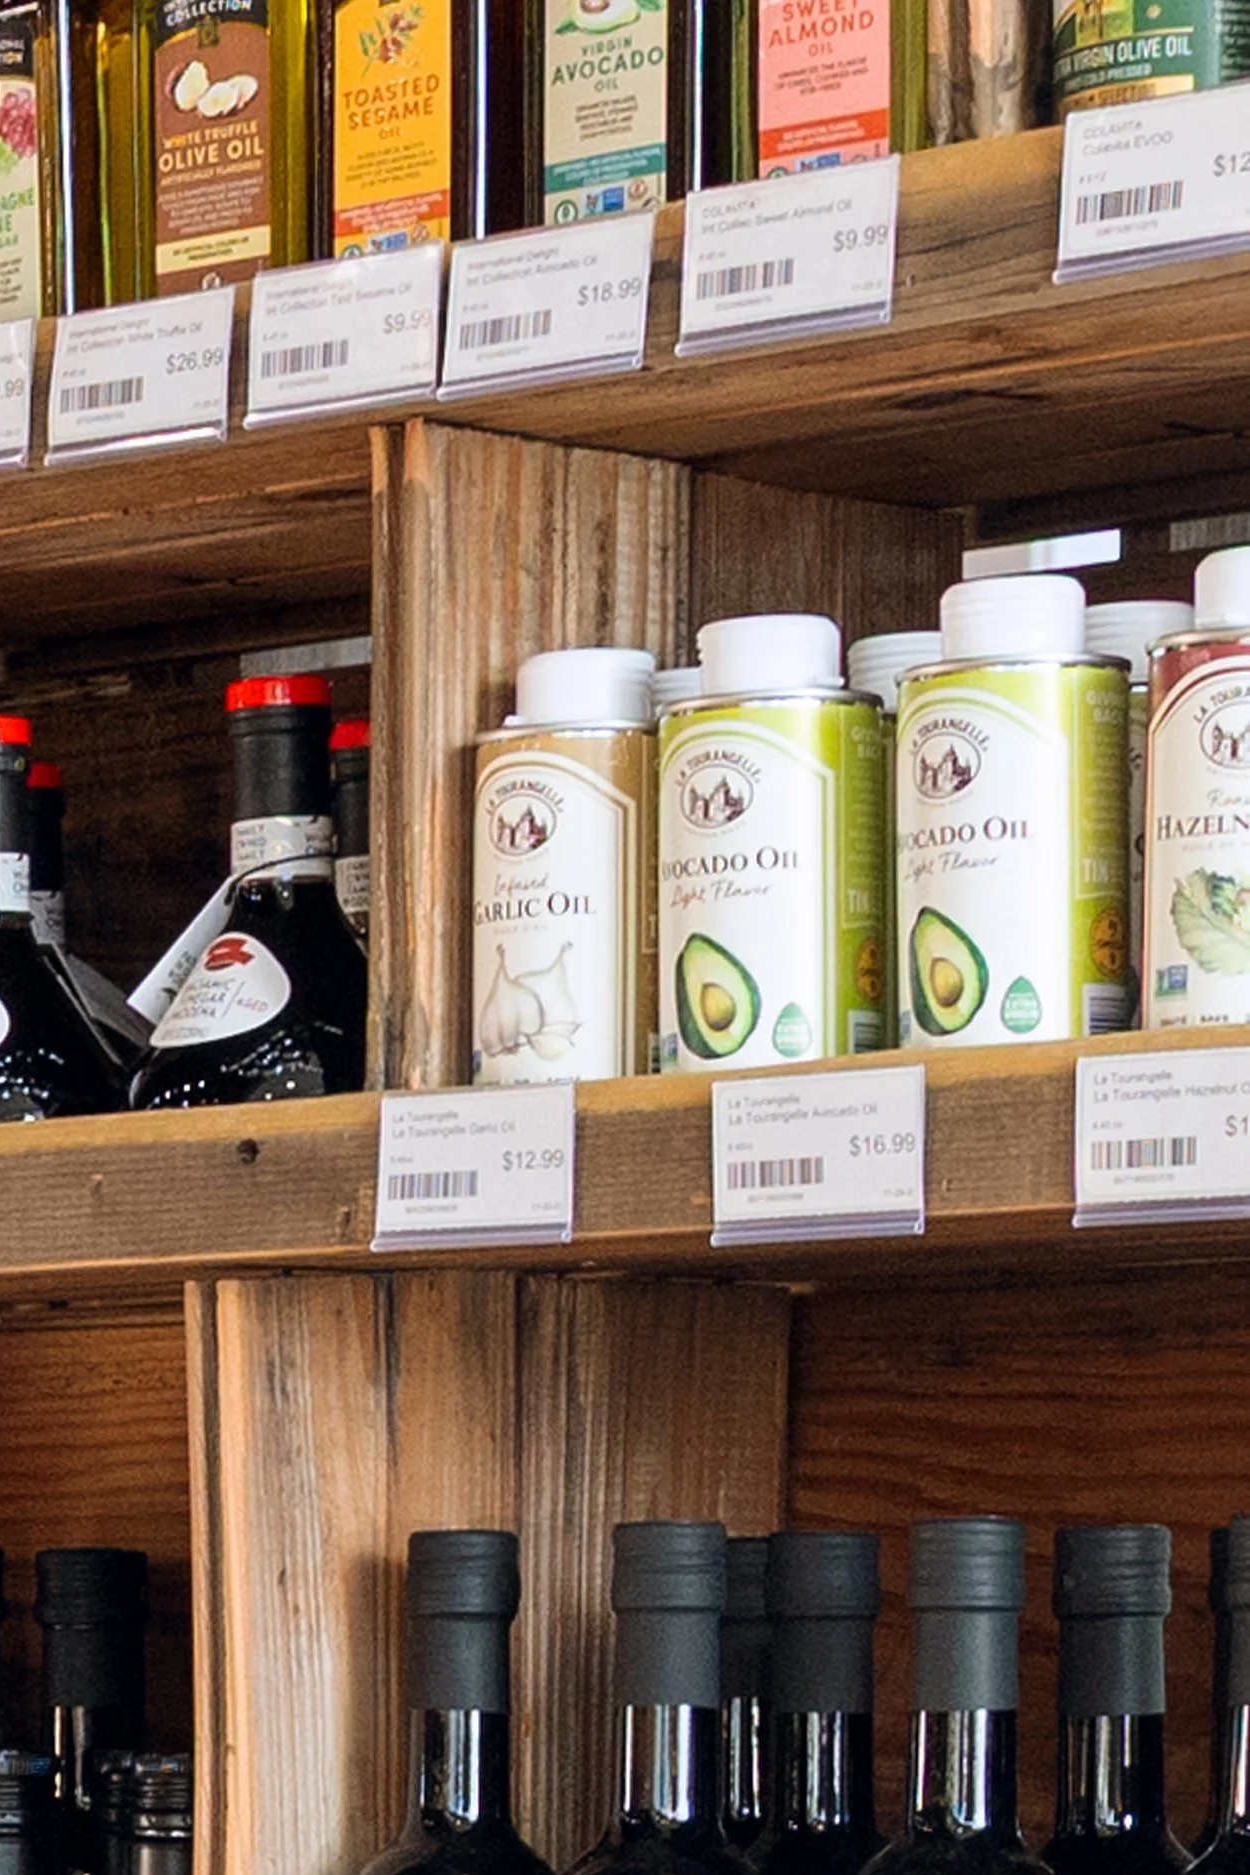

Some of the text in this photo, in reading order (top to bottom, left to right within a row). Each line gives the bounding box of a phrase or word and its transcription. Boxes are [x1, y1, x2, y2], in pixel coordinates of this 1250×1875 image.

[768, 10, 875, 49] ALMOND
[580, 35, 633, 58] VIRGIN
[808, 42, 834, 58] OIL
[1116, 35, 1162, 64] OLIVE
[1165, 34, 1194, 57] OIL
[551, 45, 665, 87] AVOCADO
[342, 73, 441, 111] TOASTED
[594, 79, 620, 93] OIL
[347, 95, 435, 132] SESAME
[163, 119, 259, 150] WHITE TRUFFLE
[1133, 130, 1174, 149] EVOO
[158, 136, 265, 174] OLIVE OIL
[832, 224, 890, 253] $9.99
[577, 277, 643, 306] $18.99
[381, 307, 432, 336] $9.99
[165, 347, 224, 376] $26.99
[983, 814, 1034, 842] OIL
[756, 845, 801, 872] OIL
[546, 890, 599, 917] OIL
[849, 1132, 916, 1157] $16.99
[502, 1149, 565, 1172] $12.99
